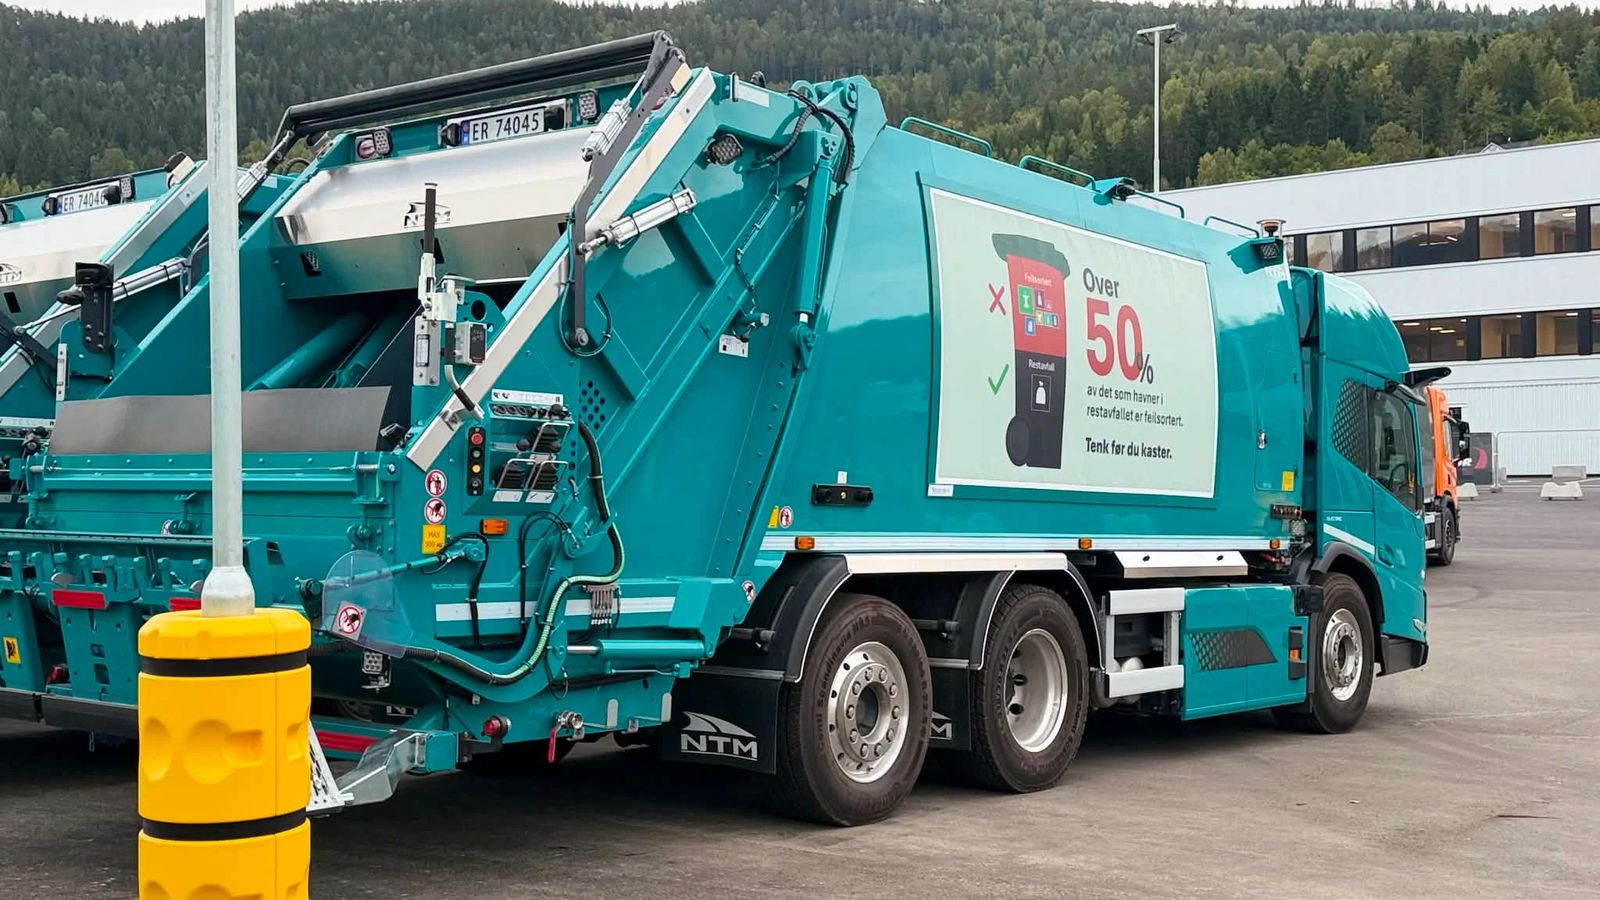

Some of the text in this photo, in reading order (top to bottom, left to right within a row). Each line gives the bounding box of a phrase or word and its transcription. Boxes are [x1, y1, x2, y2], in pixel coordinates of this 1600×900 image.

[472, 112, 540, 142] ER 74045
[63, 196, 75, 212] ER
[1083, 267, 1120, 299] Over
[1086, 297, 1154, 384] 50%
[1028, 358, 1056, 372] Restavfall
[1087, 384, 1164, 405] av det som havner i
[1086, 405, 1184, 427] restavfallet er feilsortert.
[1085, 436, 1172, 460] Tenk før du kaster.
[680, 733, 758, 759] NTM
